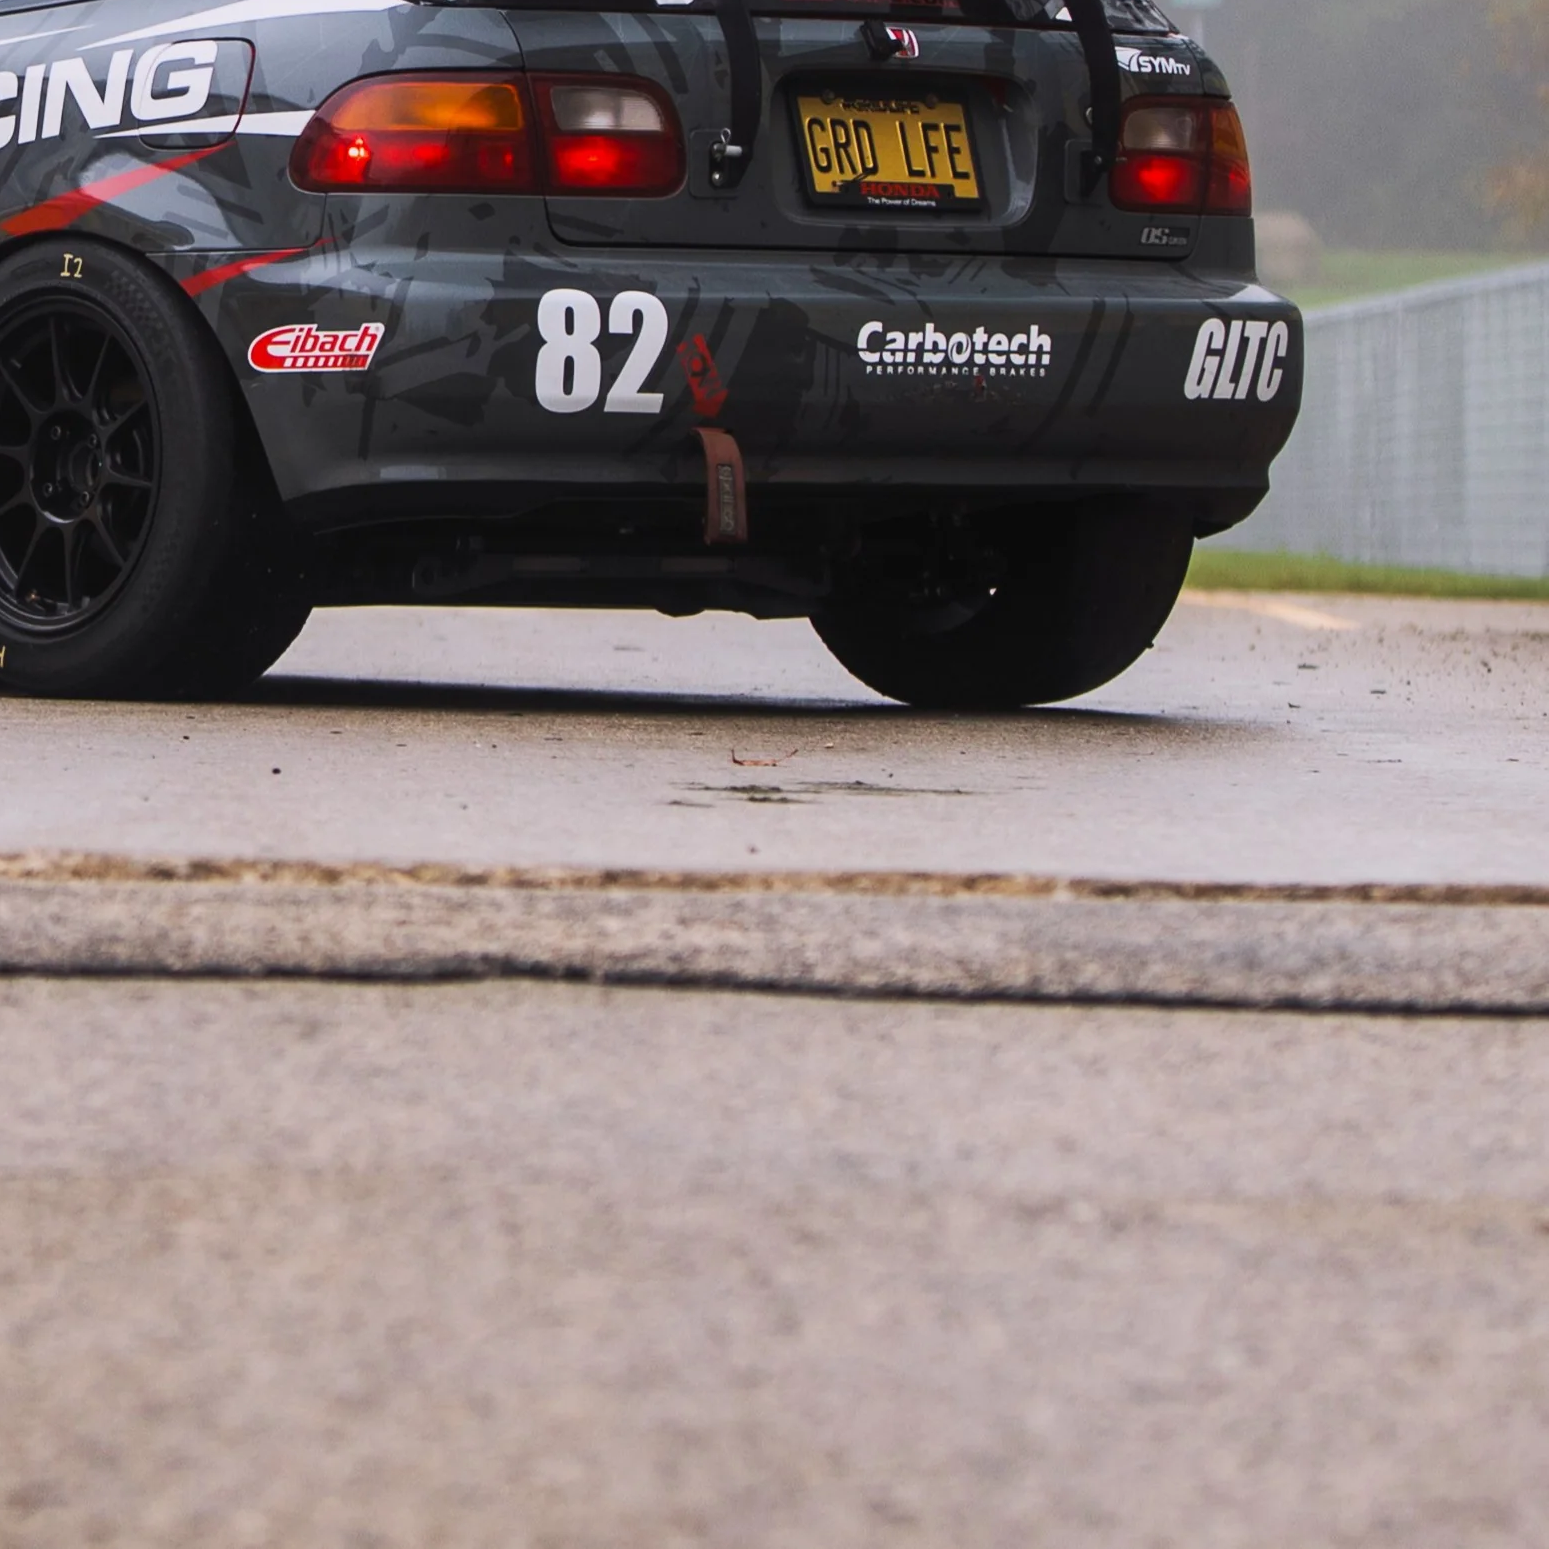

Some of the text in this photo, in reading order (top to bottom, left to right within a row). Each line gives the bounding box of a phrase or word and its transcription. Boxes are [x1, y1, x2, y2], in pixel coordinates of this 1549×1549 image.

[806, 117, 971, 180] GRD LFE
[860, 181, 940, 198] HONDA
[250, 325, 378, 368] Eibach
[534, 288, 669, 414] 82
[857, 320, 1051, 365] Carbotech
[1183, 317, 1289, 402] GLTC
[865, 365, 1046, 377] PERFORMANCE BRAKES
